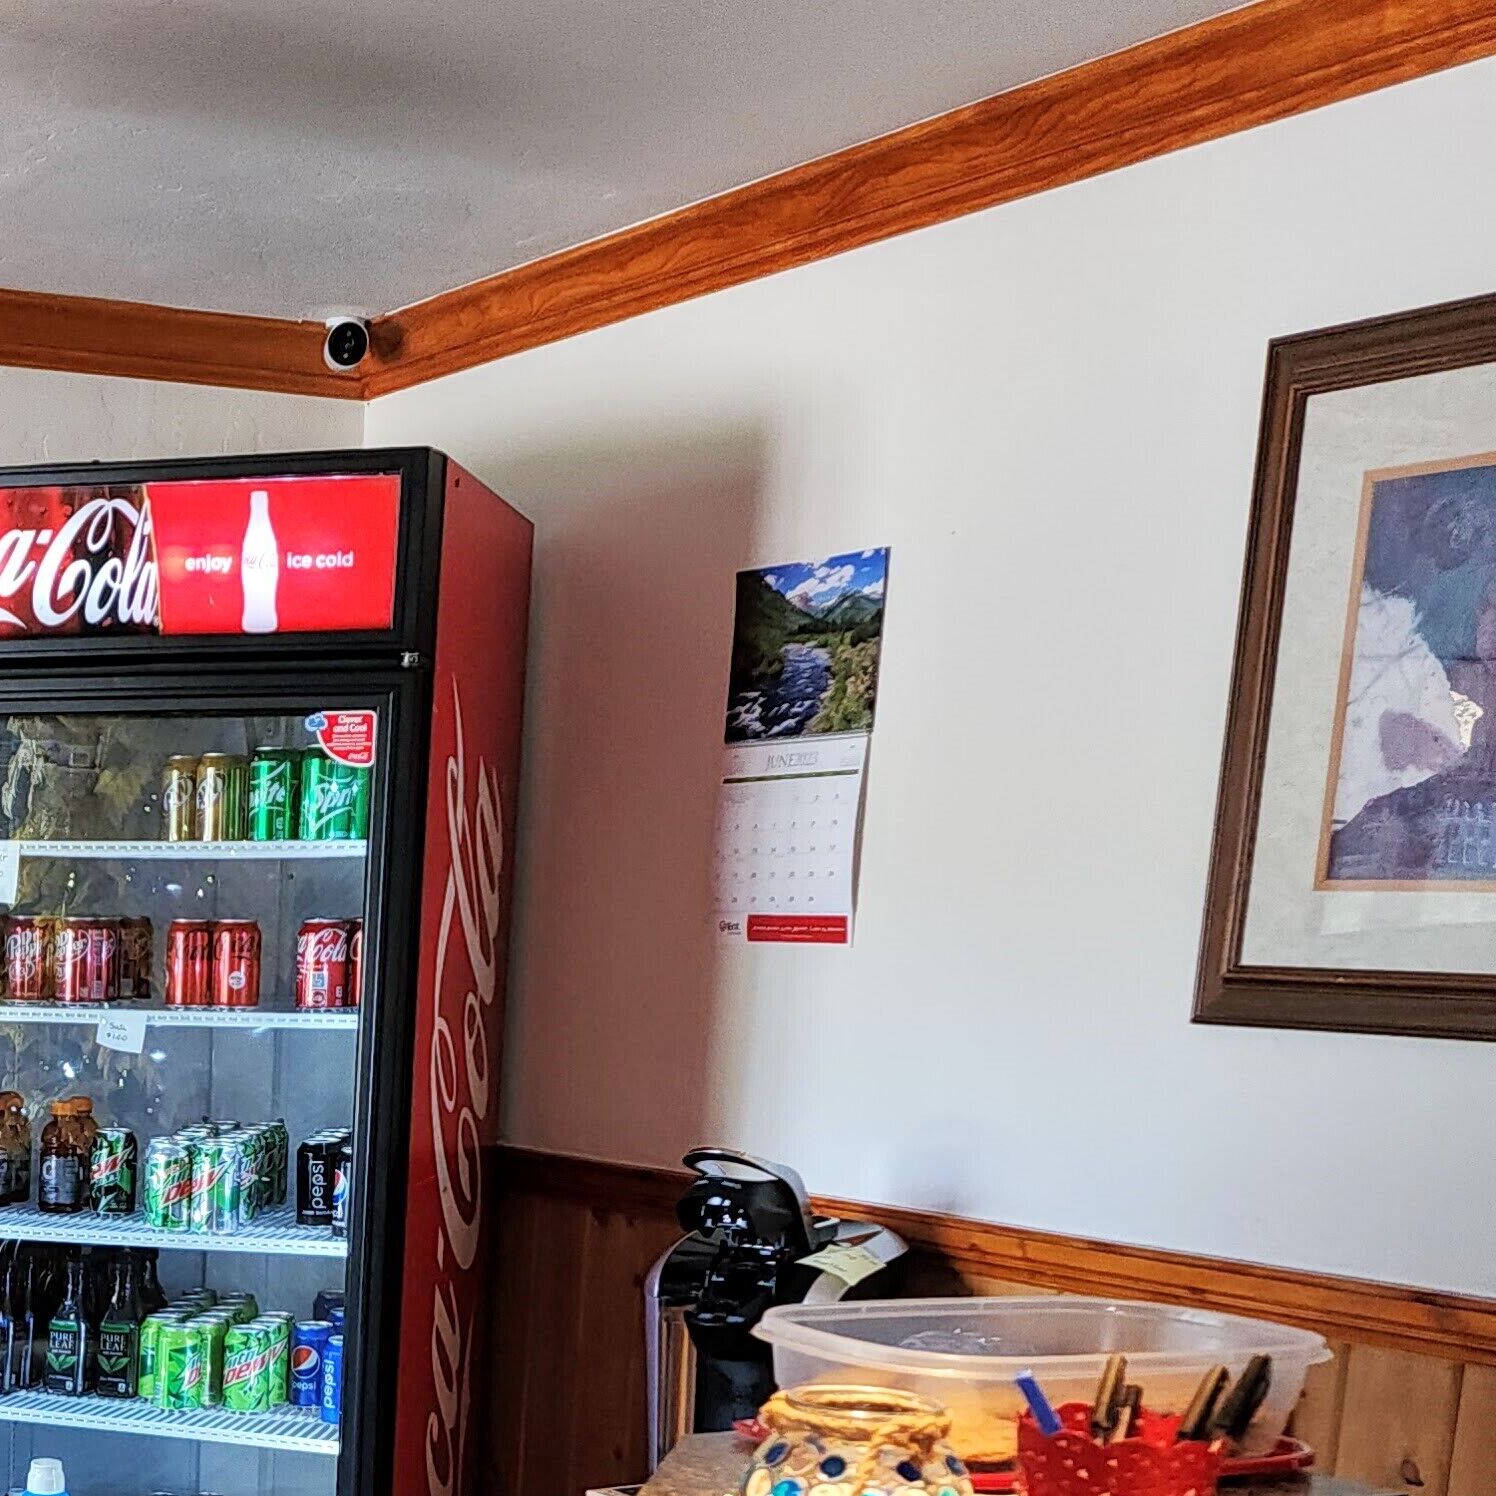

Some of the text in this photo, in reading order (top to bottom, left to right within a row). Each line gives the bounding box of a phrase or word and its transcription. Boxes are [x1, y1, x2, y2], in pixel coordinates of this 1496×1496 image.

[185, 553, 233, 574] enjoy
[287, 551, 312, 568] ice
[315, 550, 354, 568] cold
[311, 1161, 327, 1209] pepsi
[49, 1331, 75, 1342] PURE
[100, 1333, 126, 1343] PURE
[49, 1339, 75, 1350] LEAF
[292, 1380, 317, 1391] pepsi
[323, 1360, 336, 1409] pepsi
